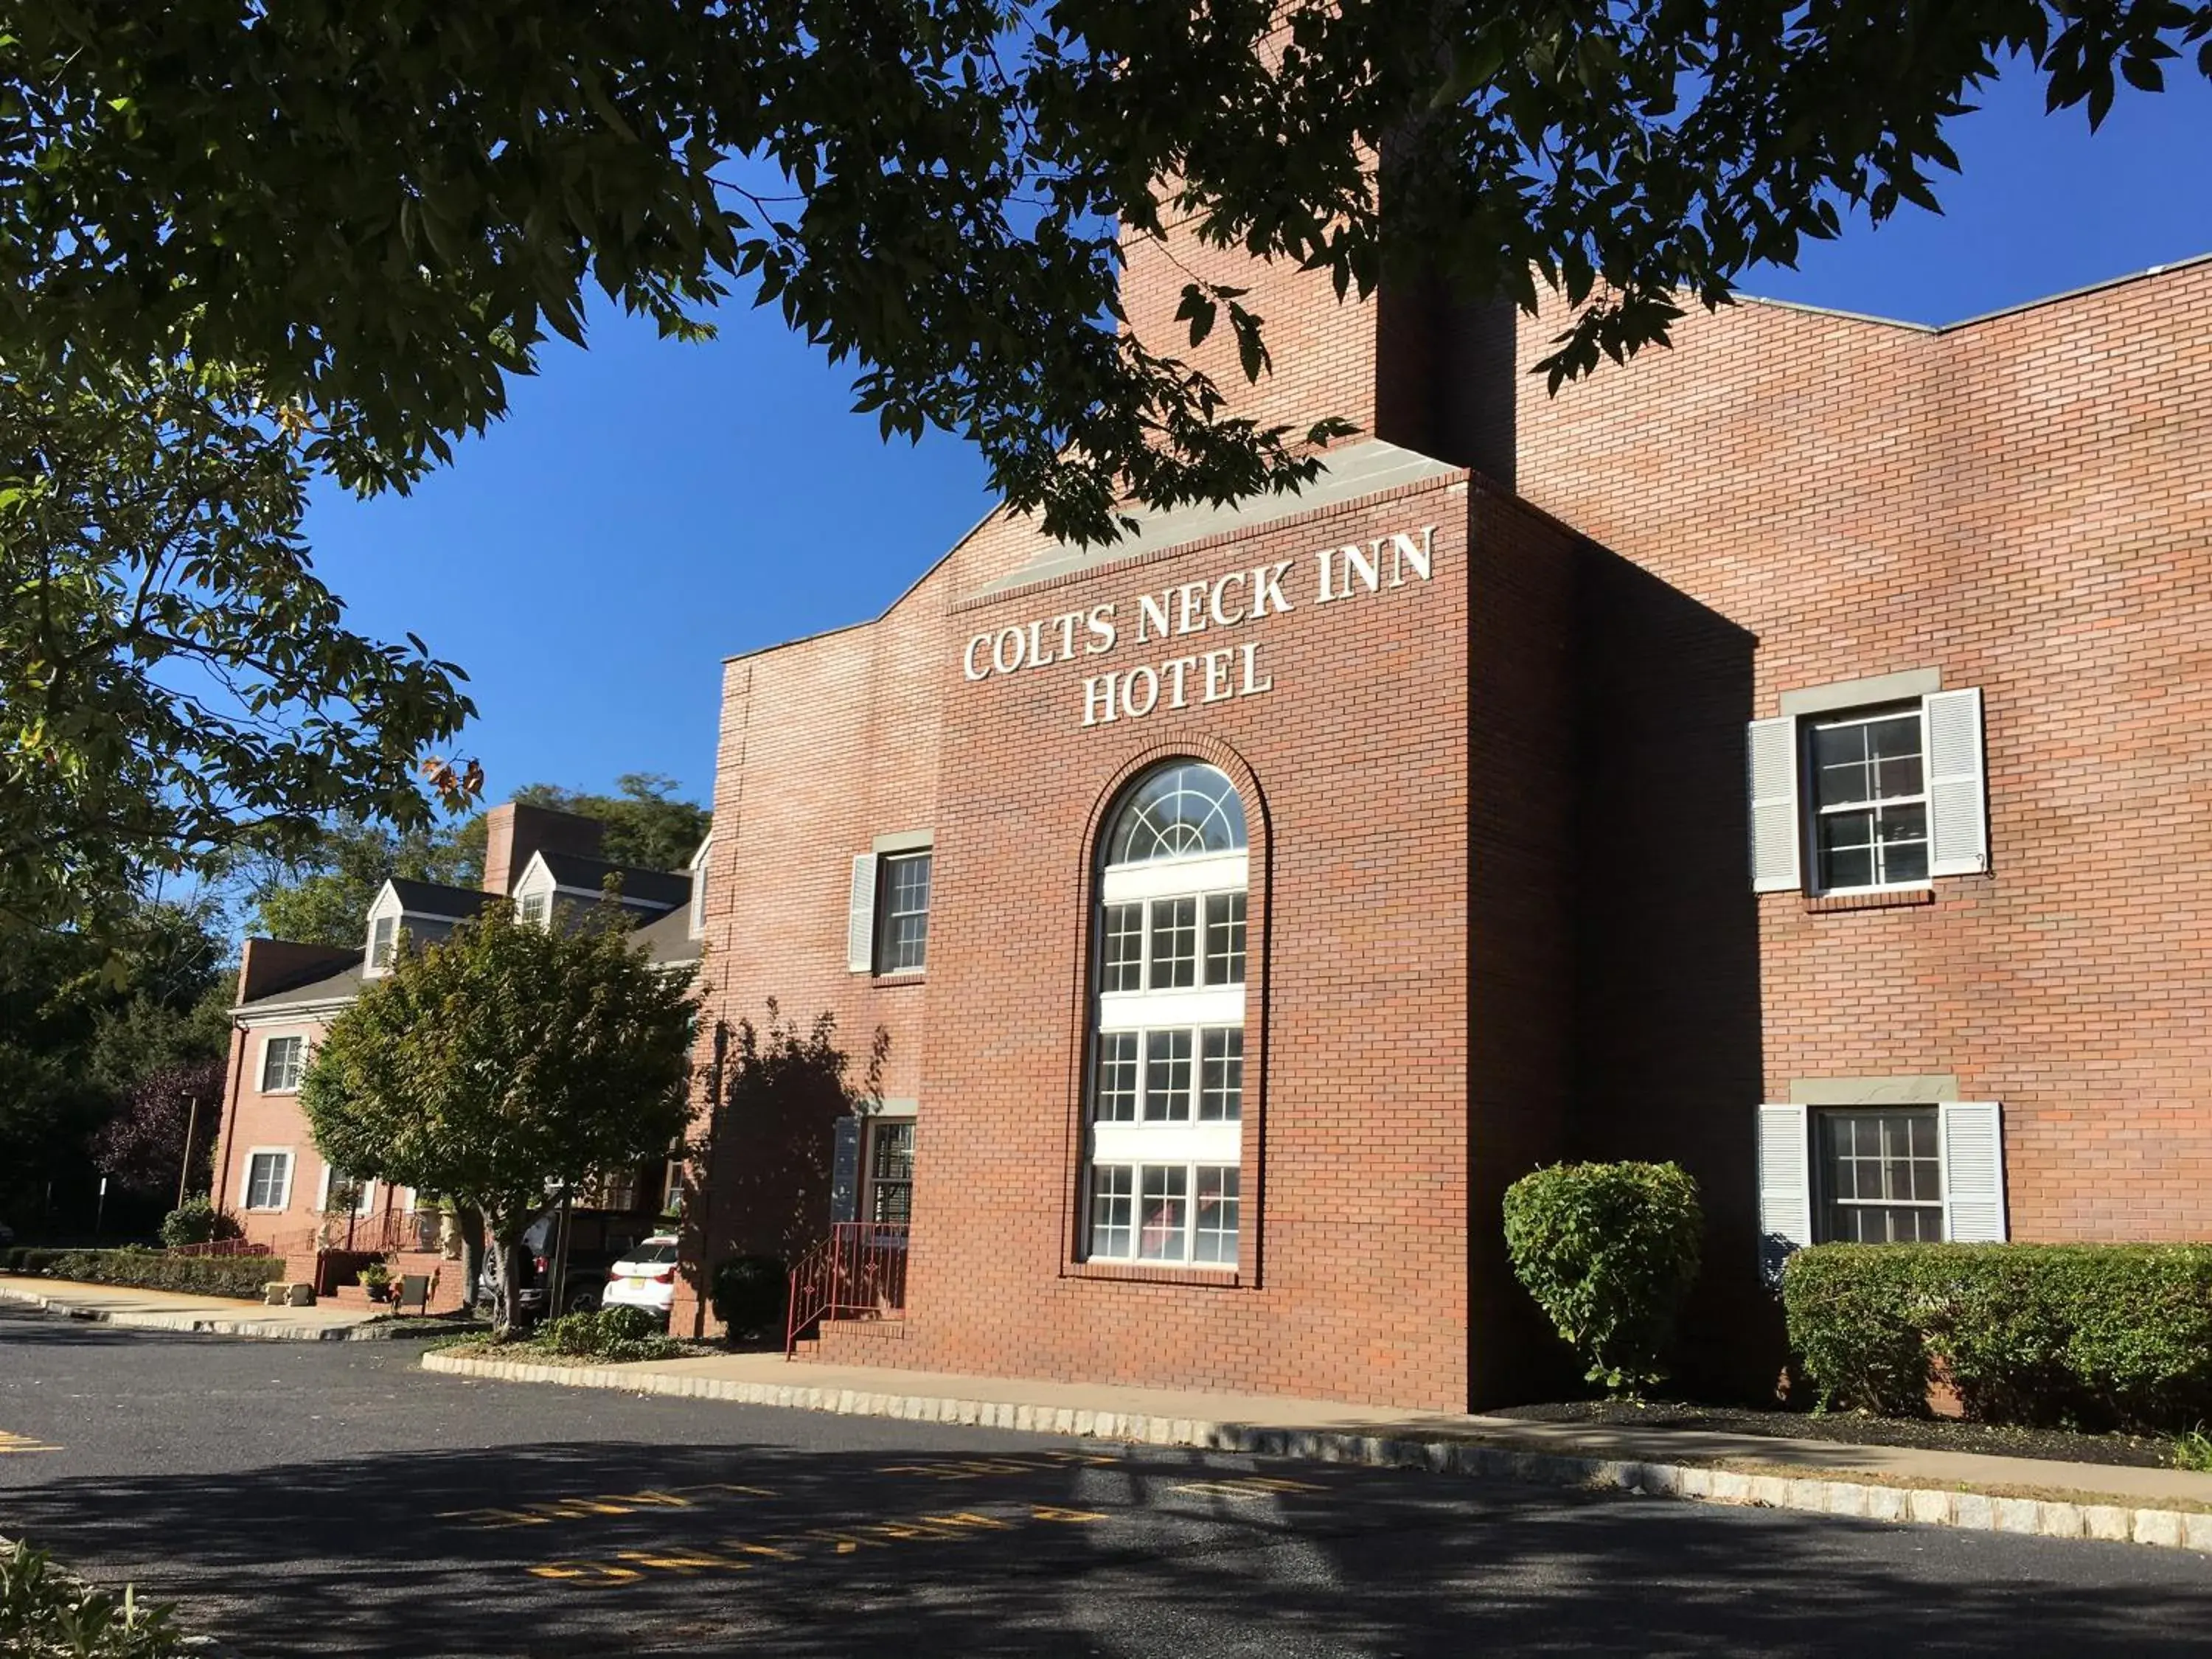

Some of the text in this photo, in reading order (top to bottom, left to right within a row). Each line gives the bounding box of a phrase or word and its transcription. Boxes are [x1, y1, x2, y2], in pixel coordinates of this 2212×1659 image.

[964, 525, 1437, 681] COLTS NECK INN
[1081, 642, 1273, 727] HOTEL
[434, 1452, 1121, 1528] FIRE LANE
[525, 1504, 1110, 1587] PARKING
